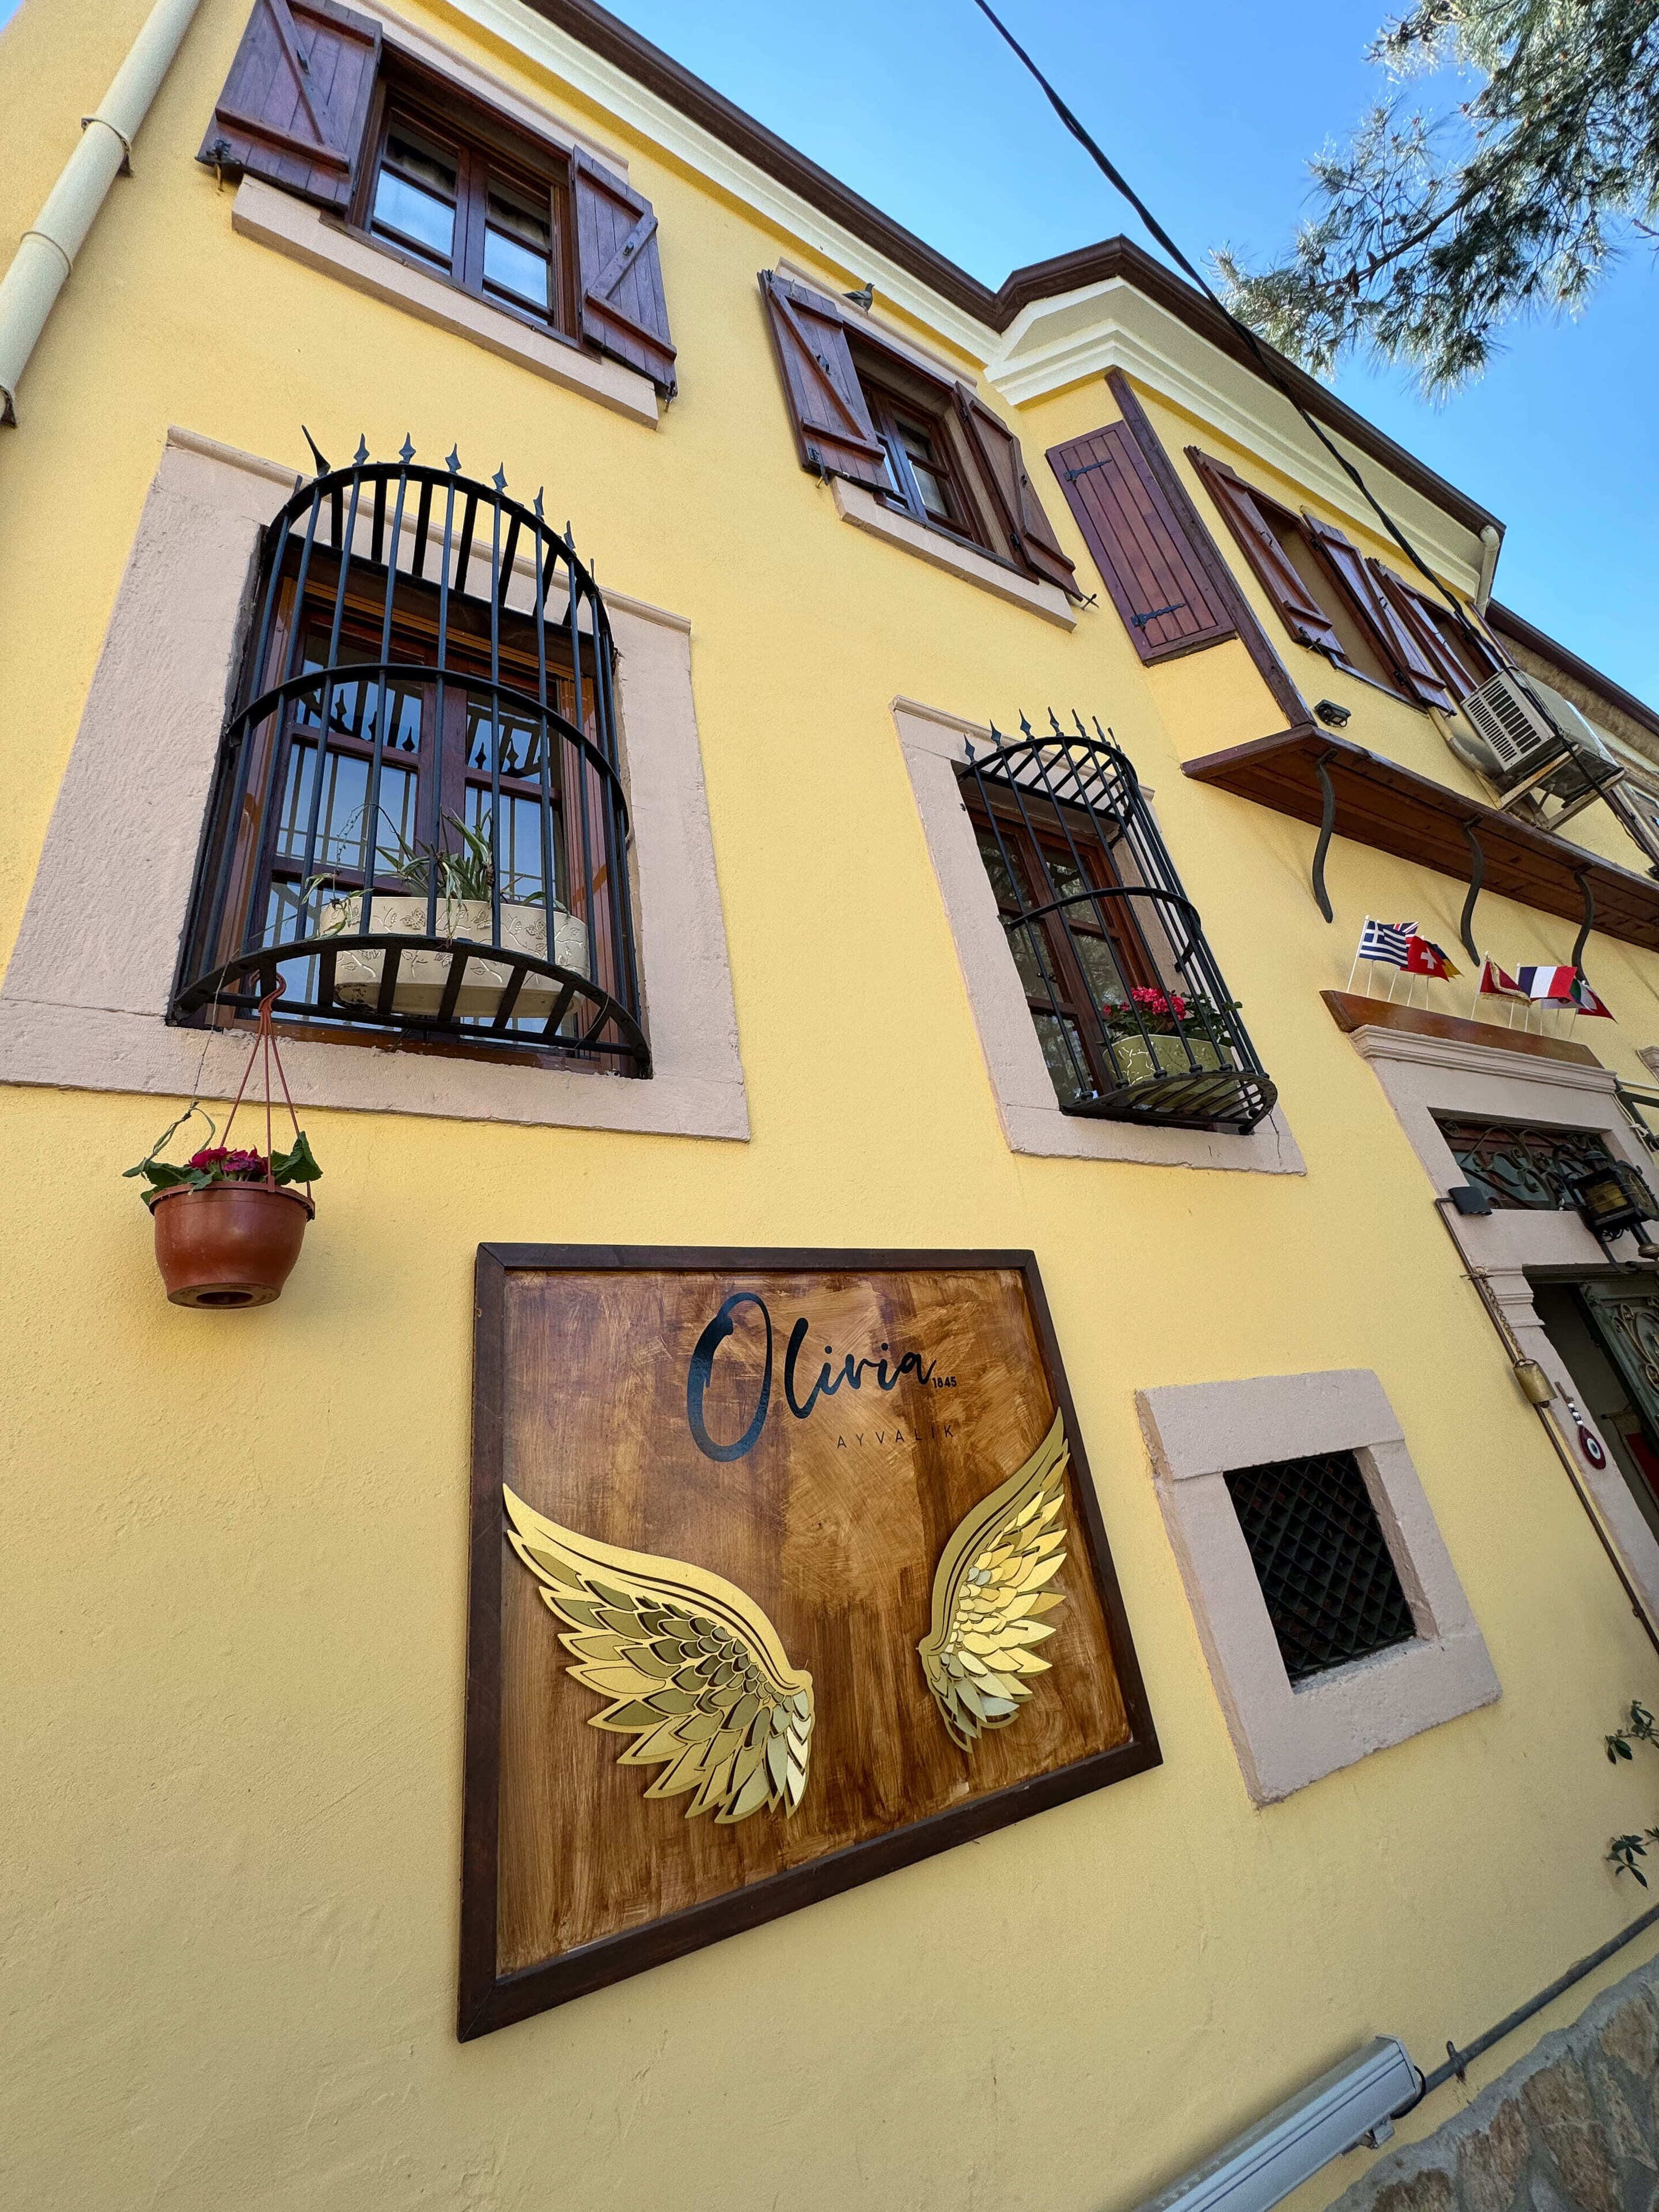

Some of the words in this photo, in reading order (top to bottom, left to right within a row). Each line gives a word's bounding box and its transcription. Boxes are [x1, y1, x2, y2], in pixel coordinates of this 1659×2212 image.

[687, 1292, 937, 1463] Olivia
[932, 1376, 957, 1388] 1845
[837, 1425, 954, 1449] AYVALIK
